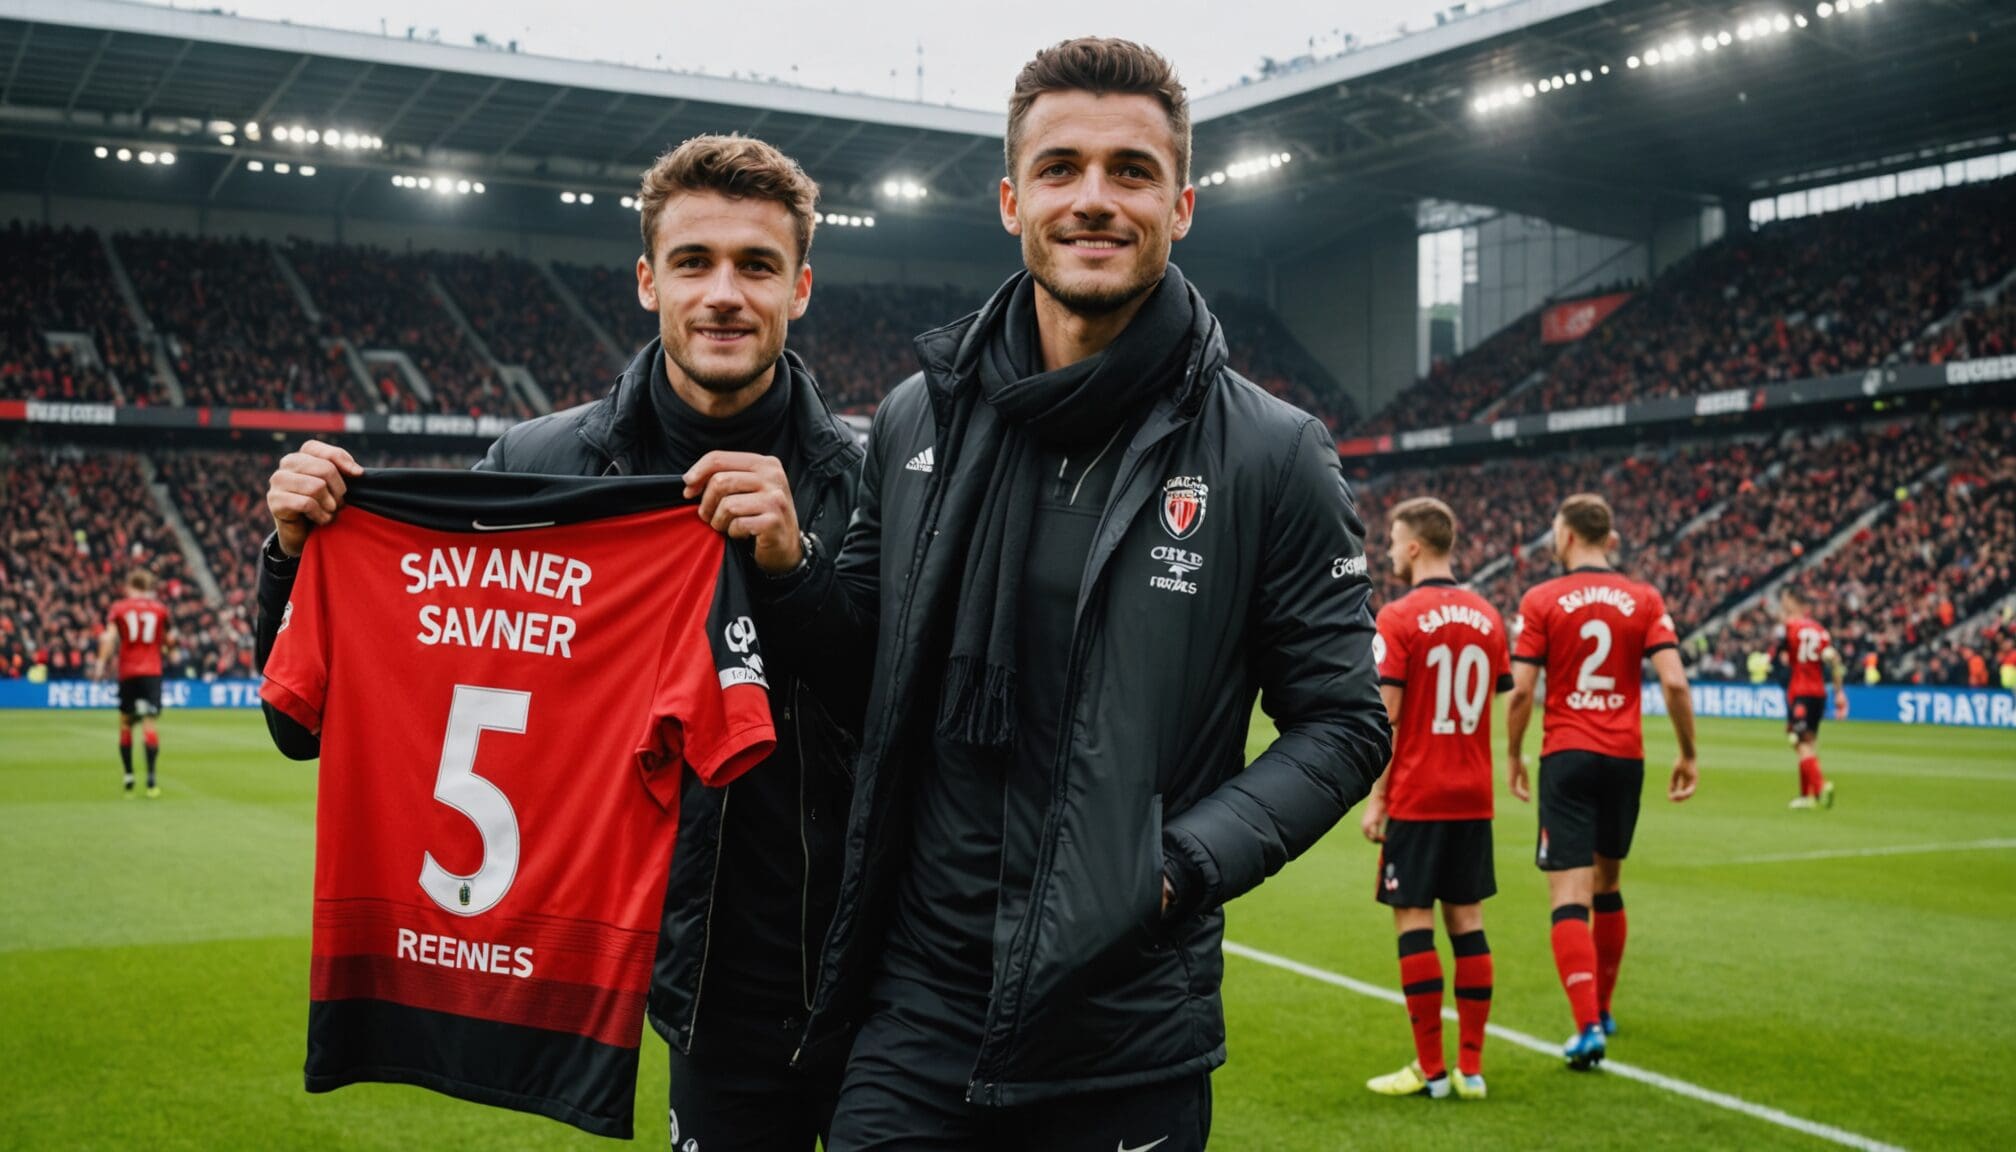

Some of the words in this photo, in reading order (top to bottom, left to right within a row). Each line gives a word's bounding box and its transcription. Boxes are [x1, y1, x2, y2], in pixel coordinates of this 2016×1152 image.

[416, 604, 577, 659] SAVNER
[1576, 618, 1615, 692] 2
[1426, 643, 1491, 736] 10
[418, 684, 532, 917] 5
